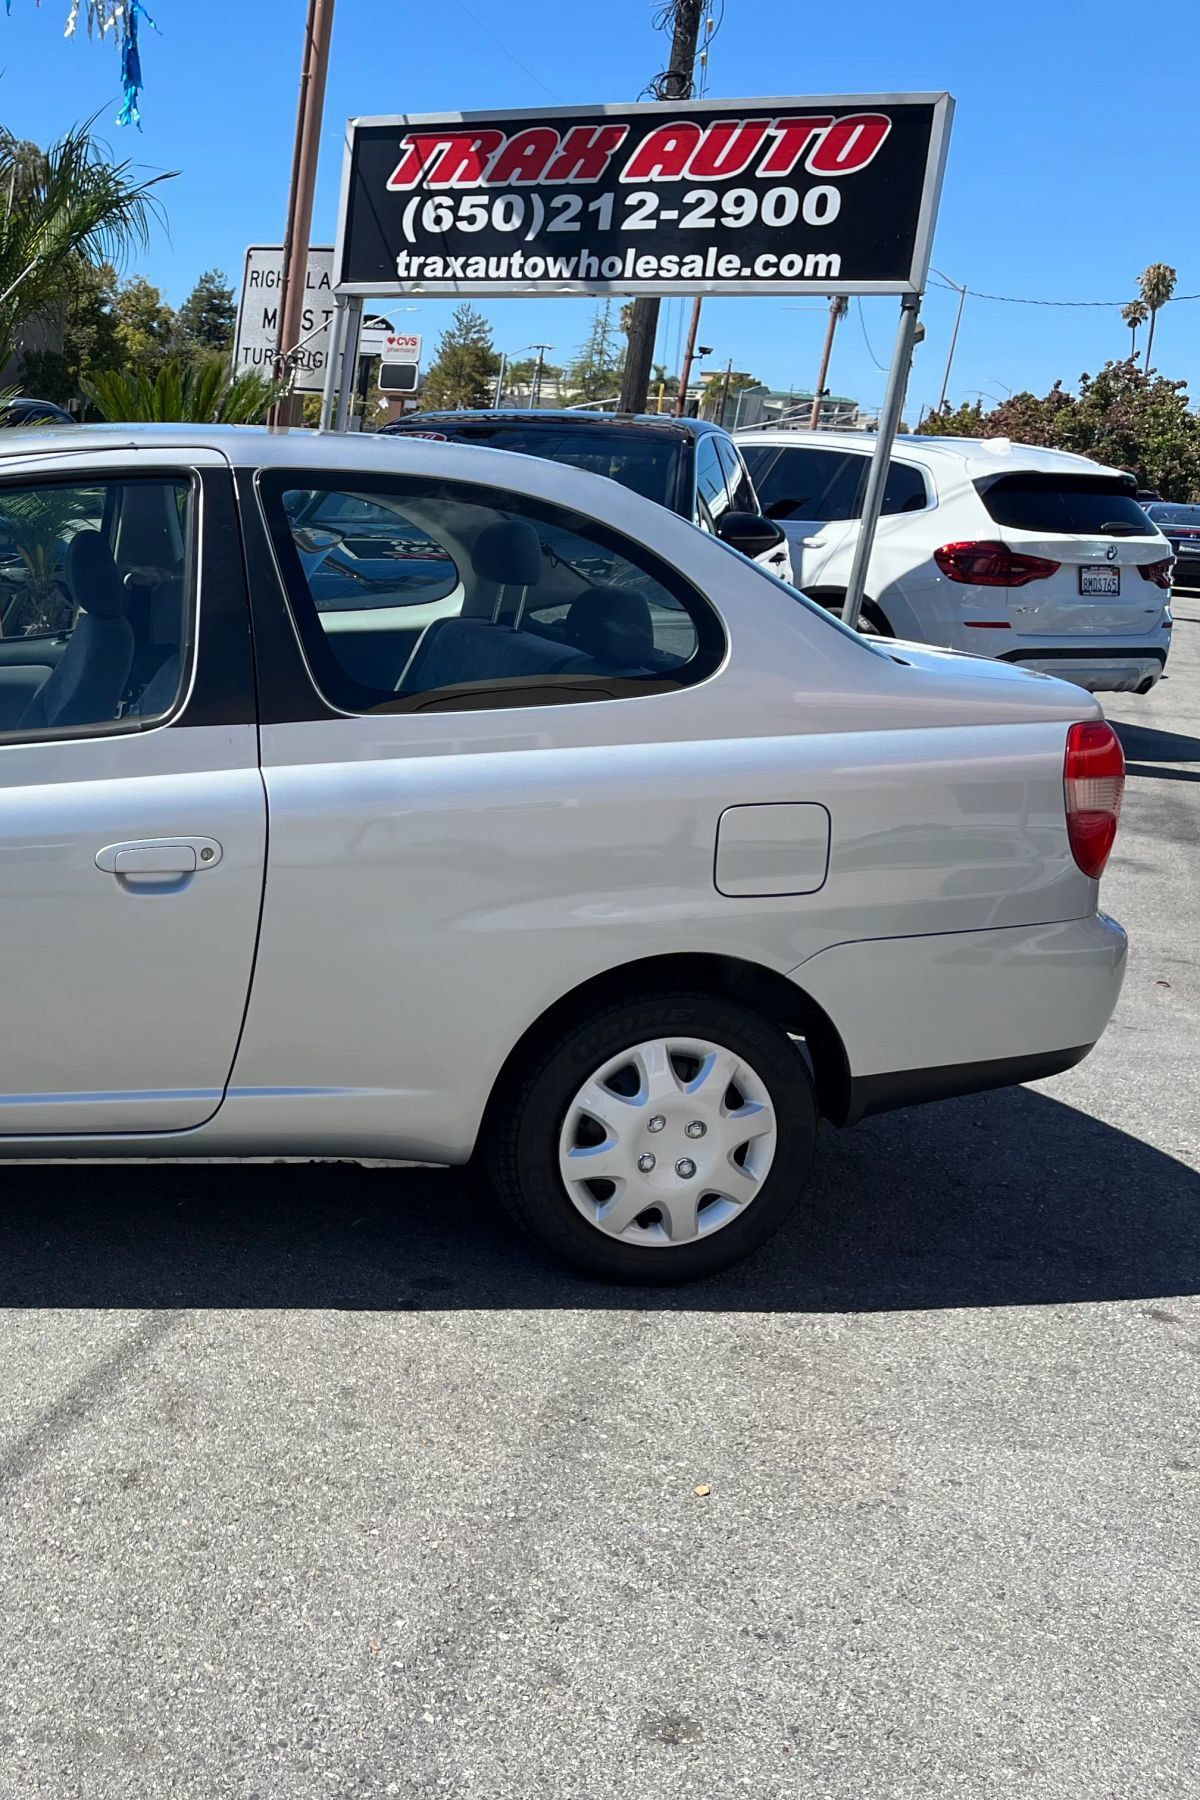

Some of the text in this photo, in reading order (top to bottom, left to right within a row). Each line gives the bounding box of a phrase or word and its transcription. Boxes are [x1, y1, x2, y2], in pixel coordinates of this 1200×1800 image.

[386, 113, 892, 191] TRAX AUTO
[402, 185, 841, 242] (650)212-2900
[396, 247, 841, 278] traxautowholesale.com
[306, 272, 331, 289] LA
[263, 308, 333, 331] MST
[396, 336, 417, 346] CVS
[243, 347, 275, 365] TUR
